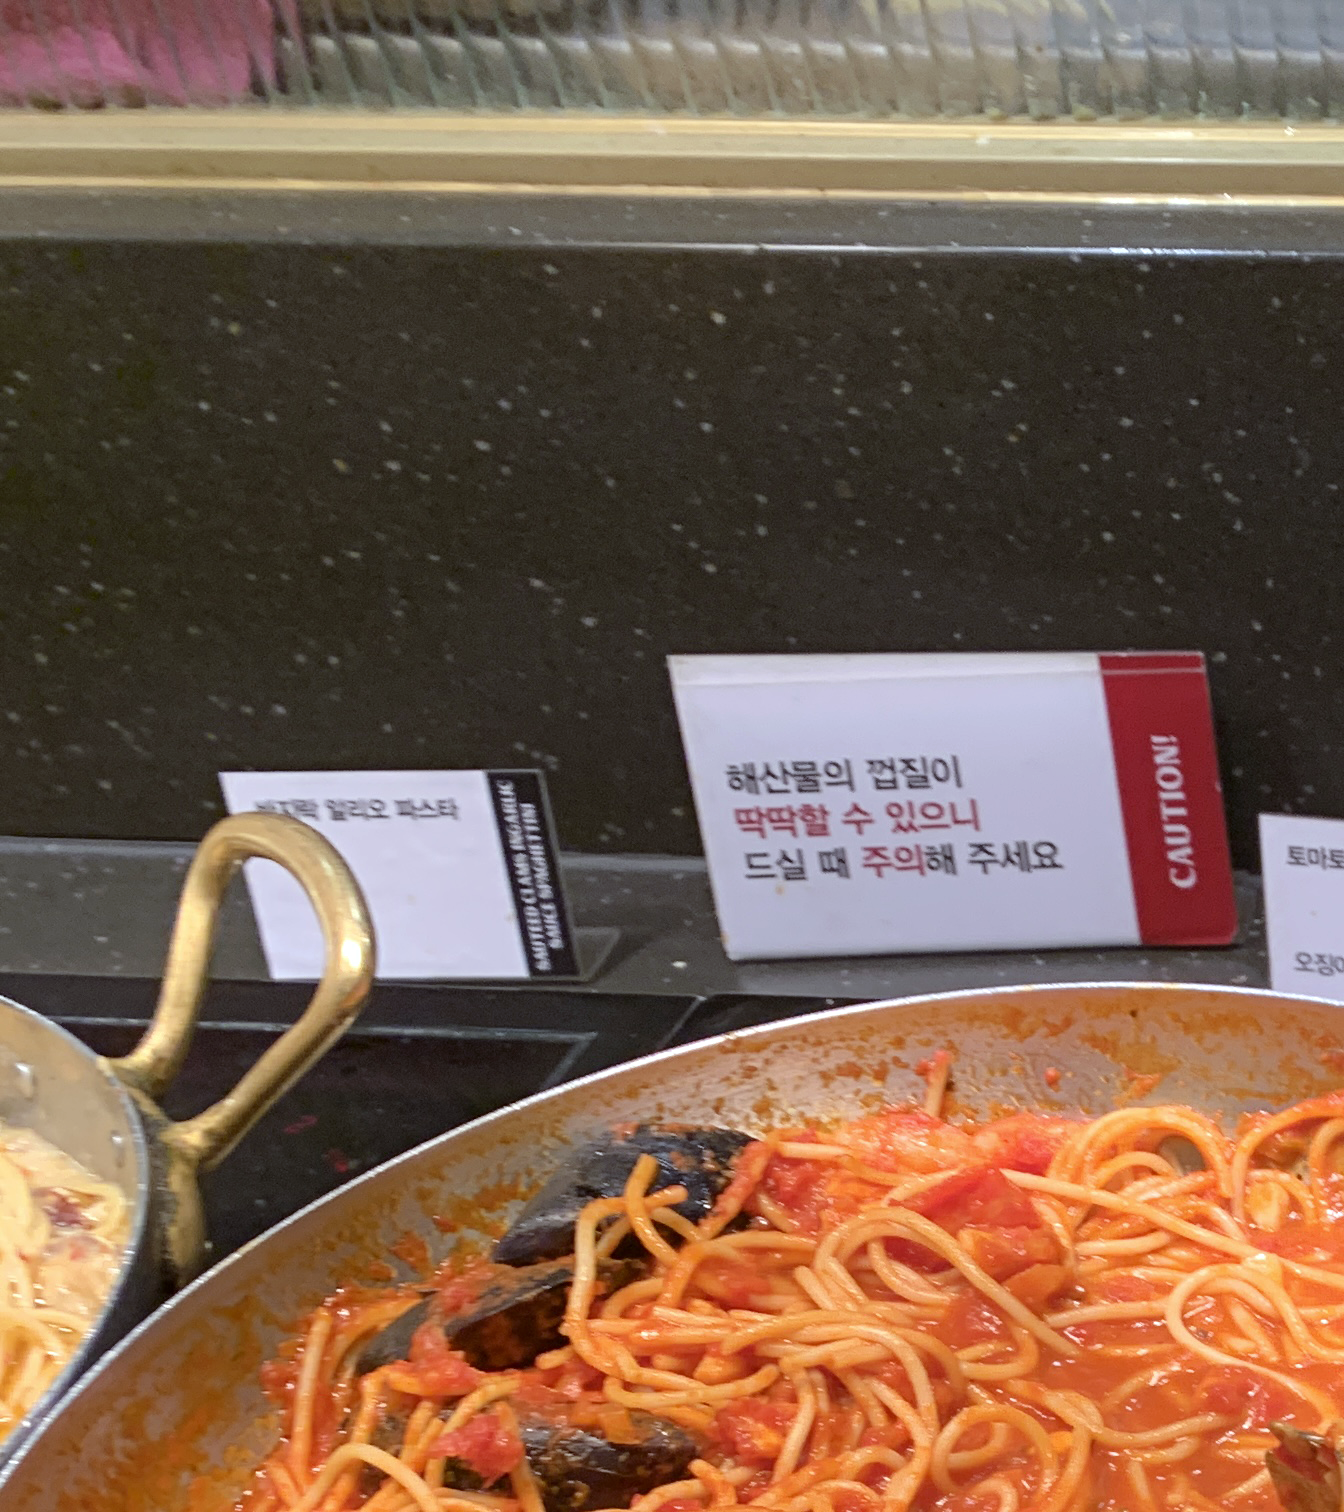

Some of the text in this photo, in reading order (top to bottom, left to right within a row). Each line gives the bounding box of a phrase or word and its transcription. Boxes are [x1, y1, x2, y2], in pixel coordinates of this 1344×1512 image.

[725, 755, 962, 795] 해산물의 껍질이
[394, 798, 460, 821] 파스타
[733, 799, 981, 839] 딱딱할 수 있으니
[1150, 734, 1198, 890] CAUTION!
[745, 840, 1064, 881] 드실 때 주의해 주세요
